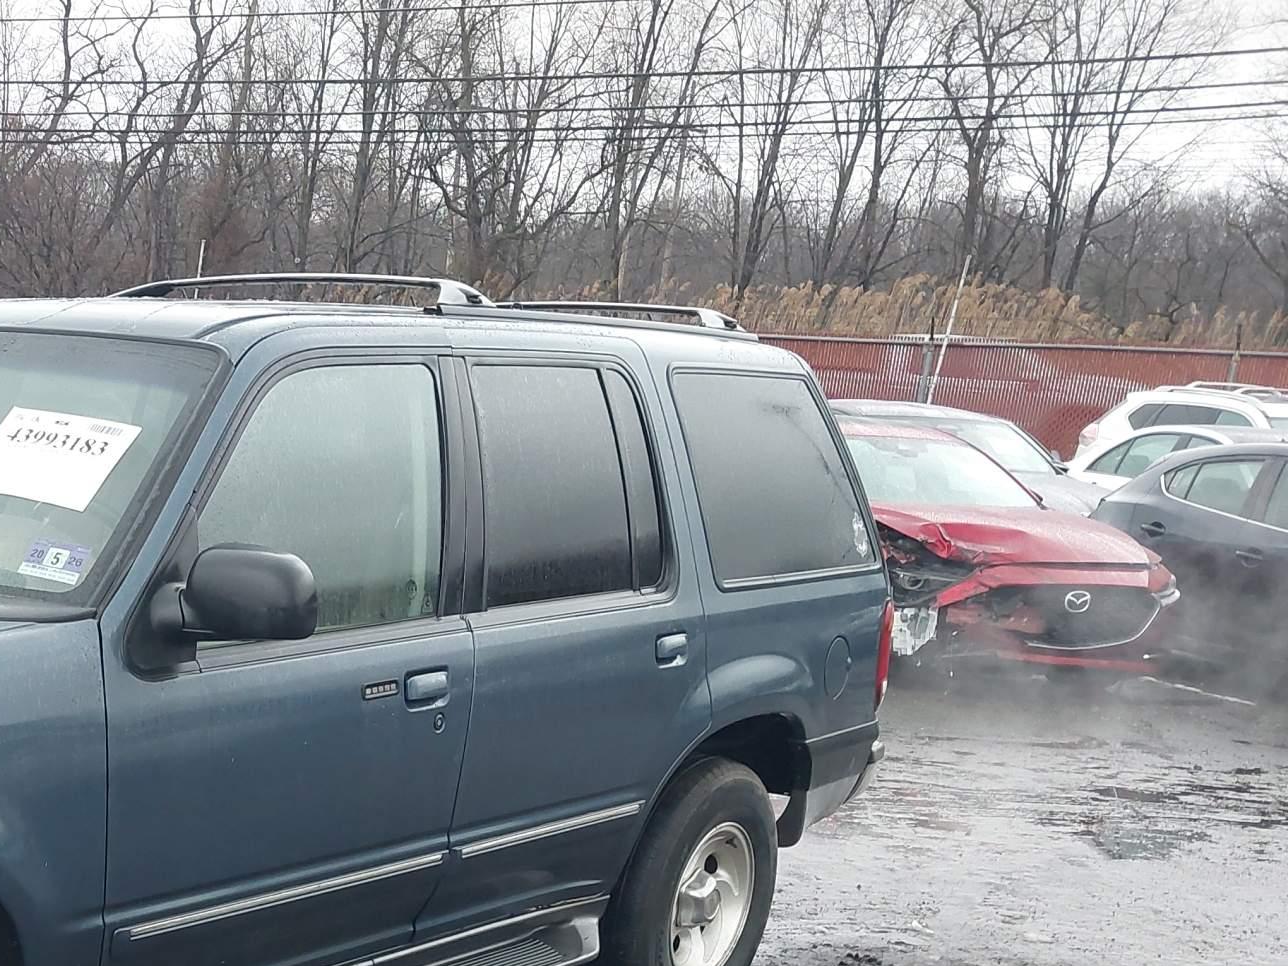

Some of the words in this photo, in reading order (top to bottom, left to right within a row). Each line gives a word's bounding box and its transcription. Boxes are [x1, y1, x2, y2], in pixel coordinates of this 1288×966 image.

[7, 427, 109, 456] 43993183
[30, 549, 45, 559] 20
[51, 552, 63, 566] 5
[68, 557, 83, 567] 26
